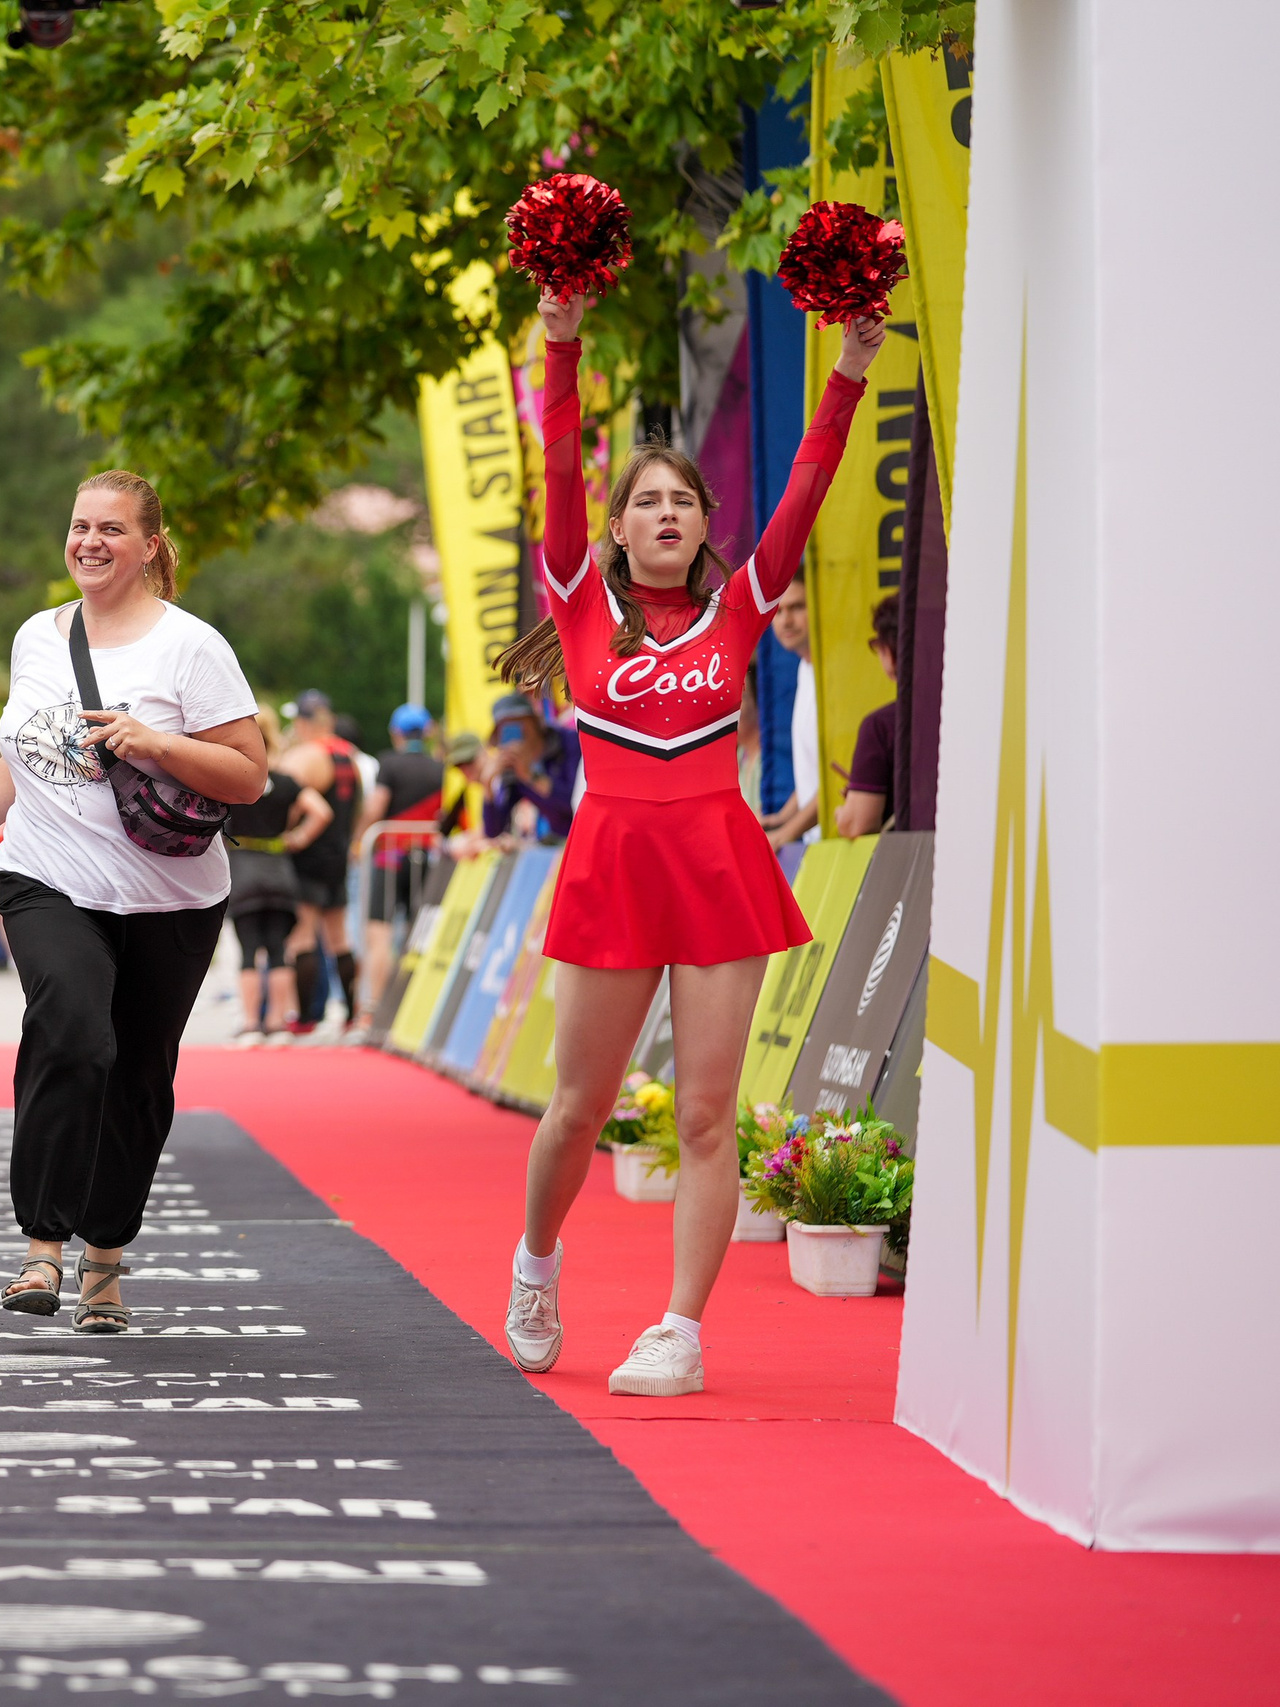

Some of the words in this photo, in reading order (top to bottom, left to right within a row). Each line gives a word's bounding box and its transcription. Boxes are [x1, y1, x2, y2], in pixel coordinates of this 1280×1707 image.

[455, 374, 513, 500] STAR
[607, 652, 724, 702] Cool
[44, 1397, 361, 1408] STAR
[56, 1494, 437, 1520] STAR
[64, 1557, 486, 1582] STAR
